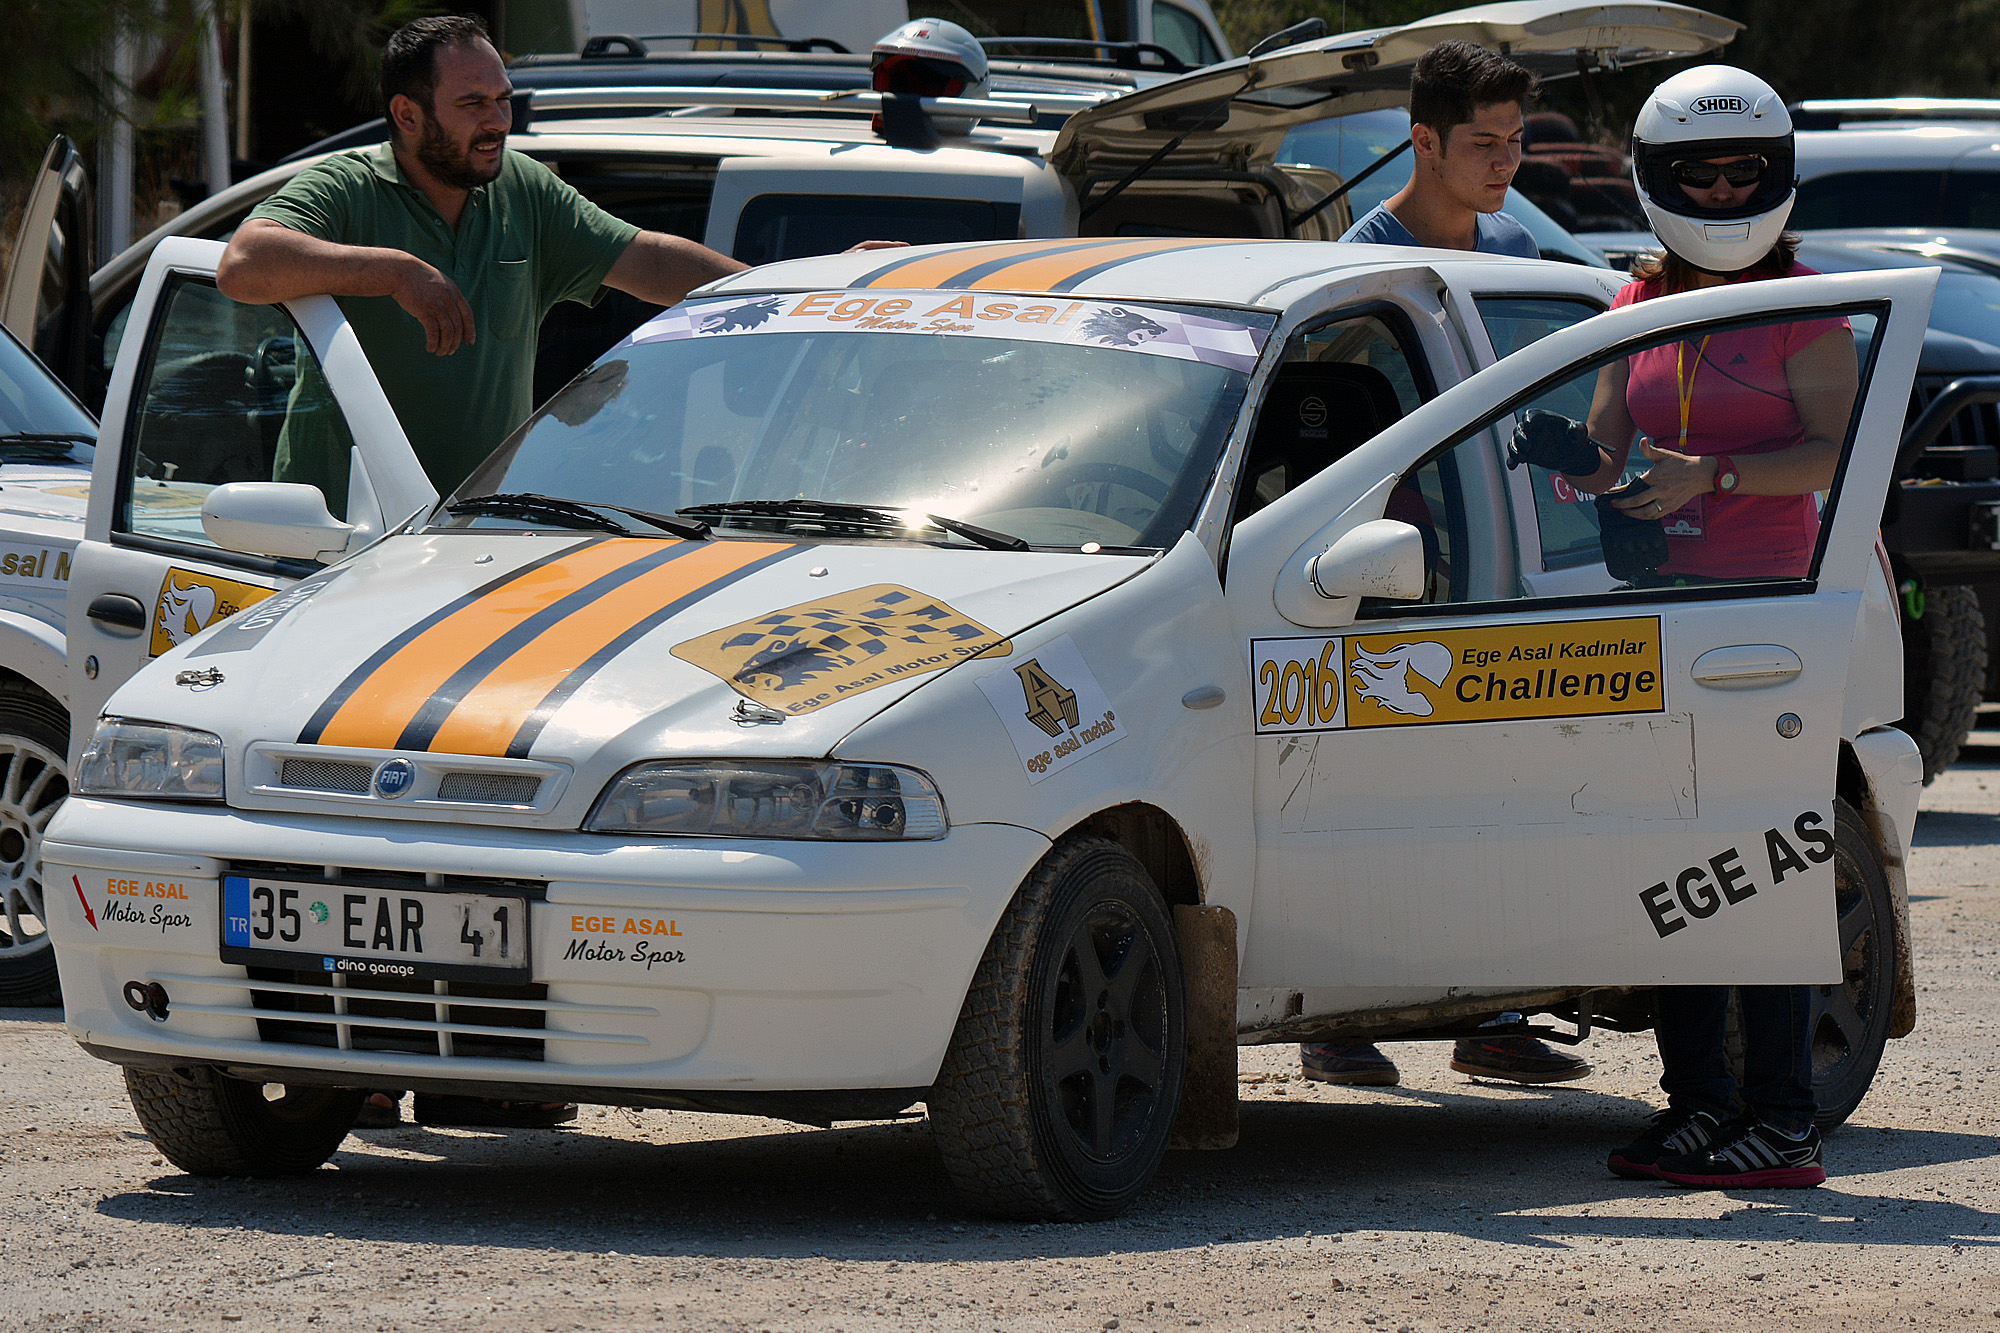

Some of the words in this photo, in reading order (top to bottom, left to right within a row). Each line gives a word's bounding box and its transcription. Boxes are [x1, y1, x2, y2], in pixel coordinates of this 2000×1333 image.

[1697, 98, 1742, 112] SHOEI
[787, 292, 913, 321] Ege
[921, 295, 1085, 326] Asal
[854, 315, 919, 331] Motor
[921, 318, 975, 335] Spor
[1461, 647, 1502, 668] Ege
[1507, 643, 1554, 662] Asal
[1559, 638, 1648, 659] Kadınlar
[785, 691, 831, 714] Ege
[835, 669, 884, 694] Asal
[887, 649, 948, 675] Motor
[1260, 639, 1341, 727] 2016
[1455, 667, 1657, 703] Challenge
[1026, 750, 1054, 774] ege
[1053, 730, 1082, 759] asal
[380, 770, 408, 787] FIAT
[107, 878, 139, 897] EGE
[144, 881, 189, 900] ASAL
[1638, 847, 1758, 939] EGE
[1763, 810, 1835, 885] AS
[101, 899, 147, 924] Motor
[149, 903, 193, 934] Spor
[229, 916, 248, 933] TR
[252, 886, 301, 943] 35
[343, 893, 424, 954] EAR
[459, 902, 509, 959] 41
[571, 915, 616, 933] EGE
[622, 918, 684, 937] ASAL
[336, 958, 367, 973] dino
[368, 962, 415, 976] garage
[563, 938, 626, 962] Motor
[630, 940, 686, 971] Spor
